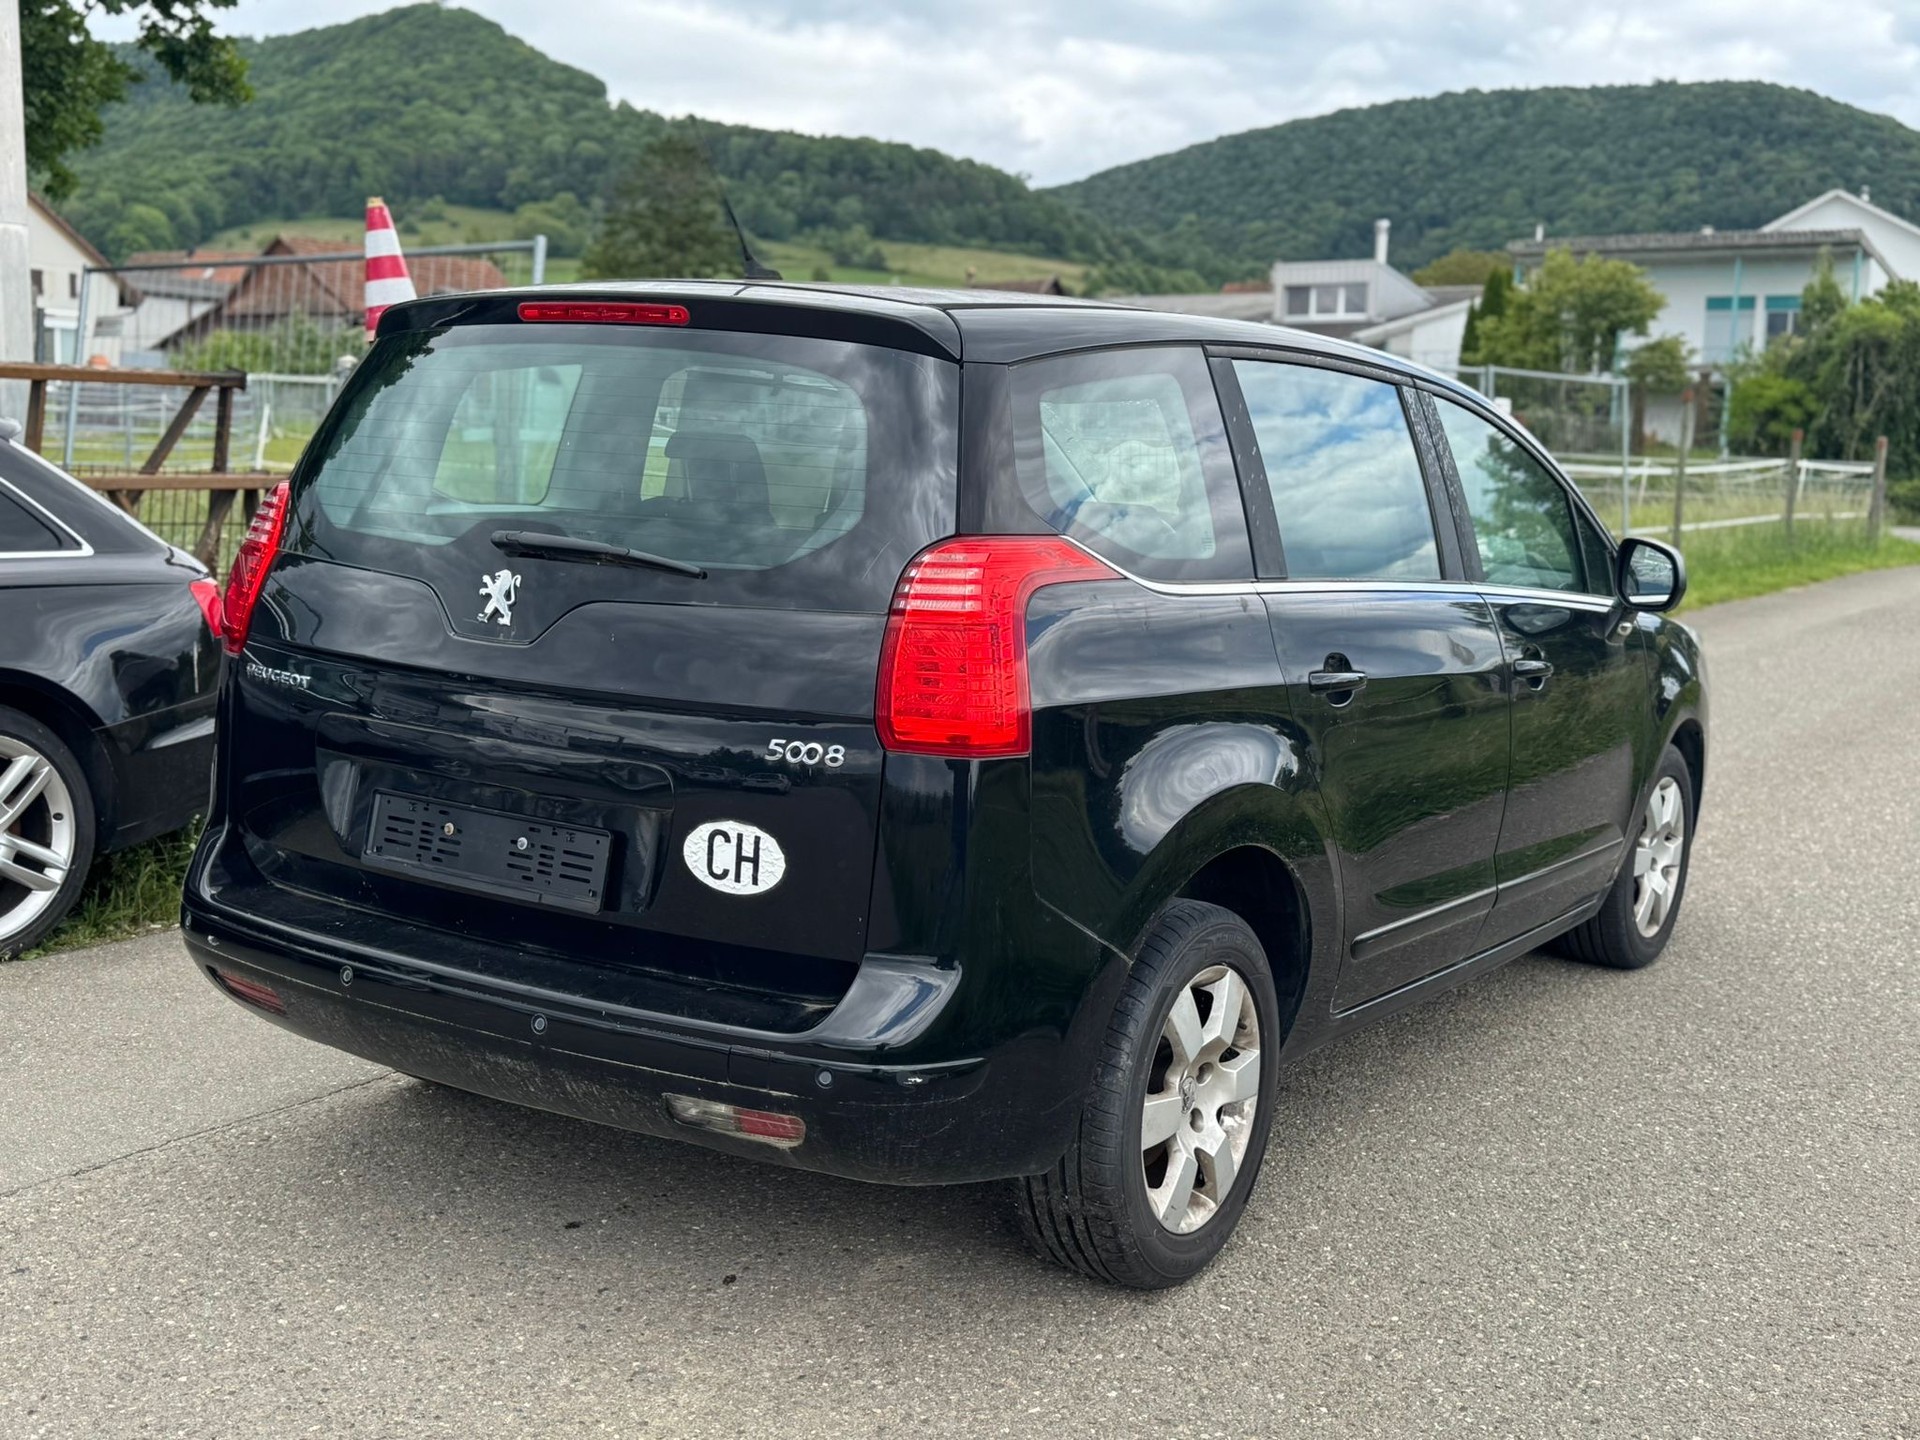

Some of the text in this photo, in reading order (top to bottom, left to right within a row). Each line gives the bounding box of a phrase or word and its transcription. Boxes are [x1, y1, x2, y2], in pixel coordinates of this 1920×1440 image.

[246, 662, 311, 688] PEUGEOT
[764, 738, 846, 768] 5008
[706, 828, 761, 886] CH
